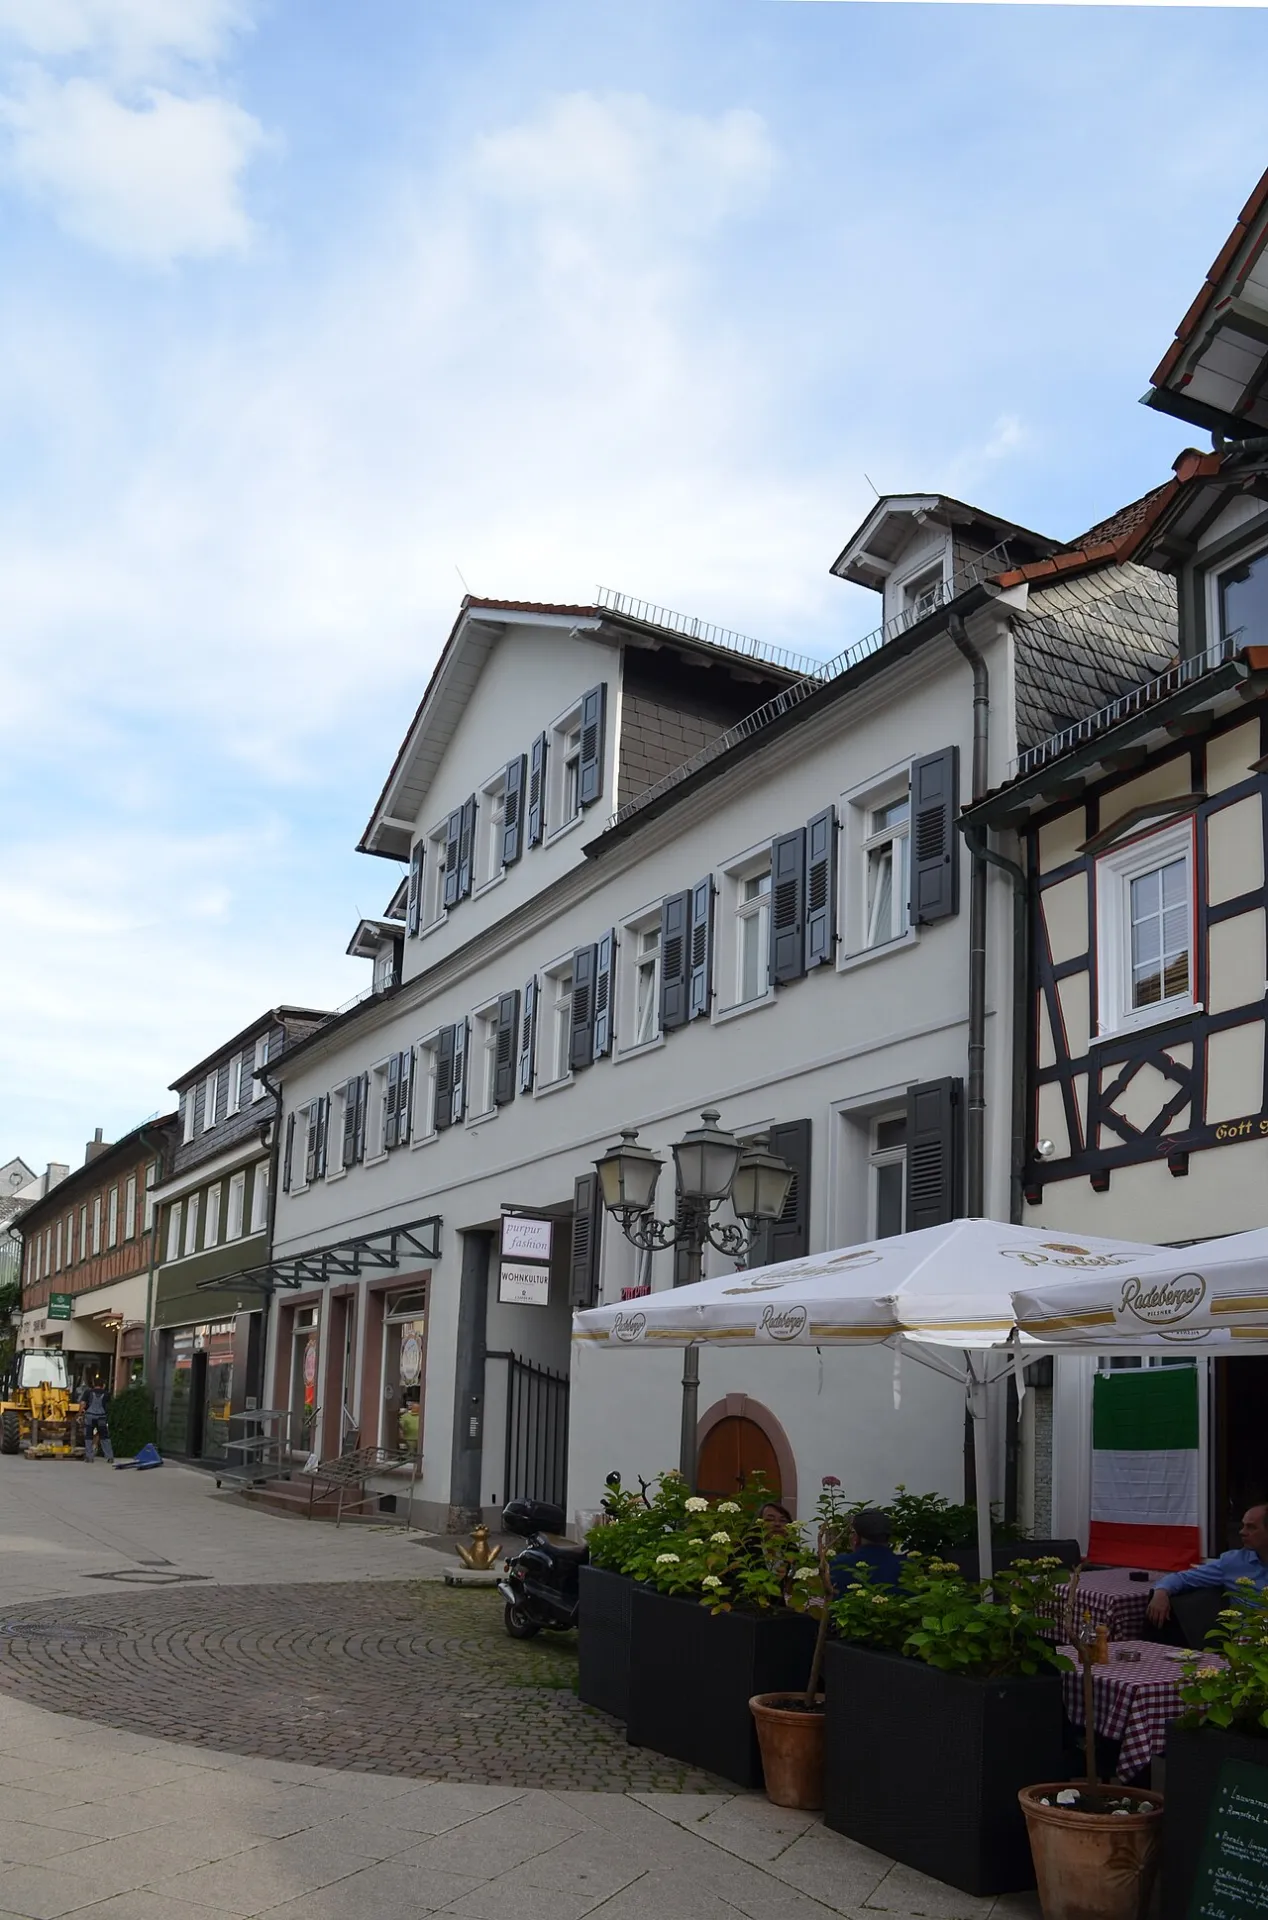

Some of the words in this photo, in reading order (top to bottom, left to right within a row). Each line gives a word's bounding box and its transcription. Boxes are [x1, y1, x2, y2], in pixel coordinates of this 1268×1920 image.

[1215, 1120, 1253, 1140] Gott
[506, 1224, 543, 1236] purpur
[509, 1236, 548, 1250] fashion
[501, 1272, 548, 1284] WOHNKULTUR
[1118, 1276, 1202, 1312] Radeberger
[1147, 1309, 1172, 1317] PILSNER
